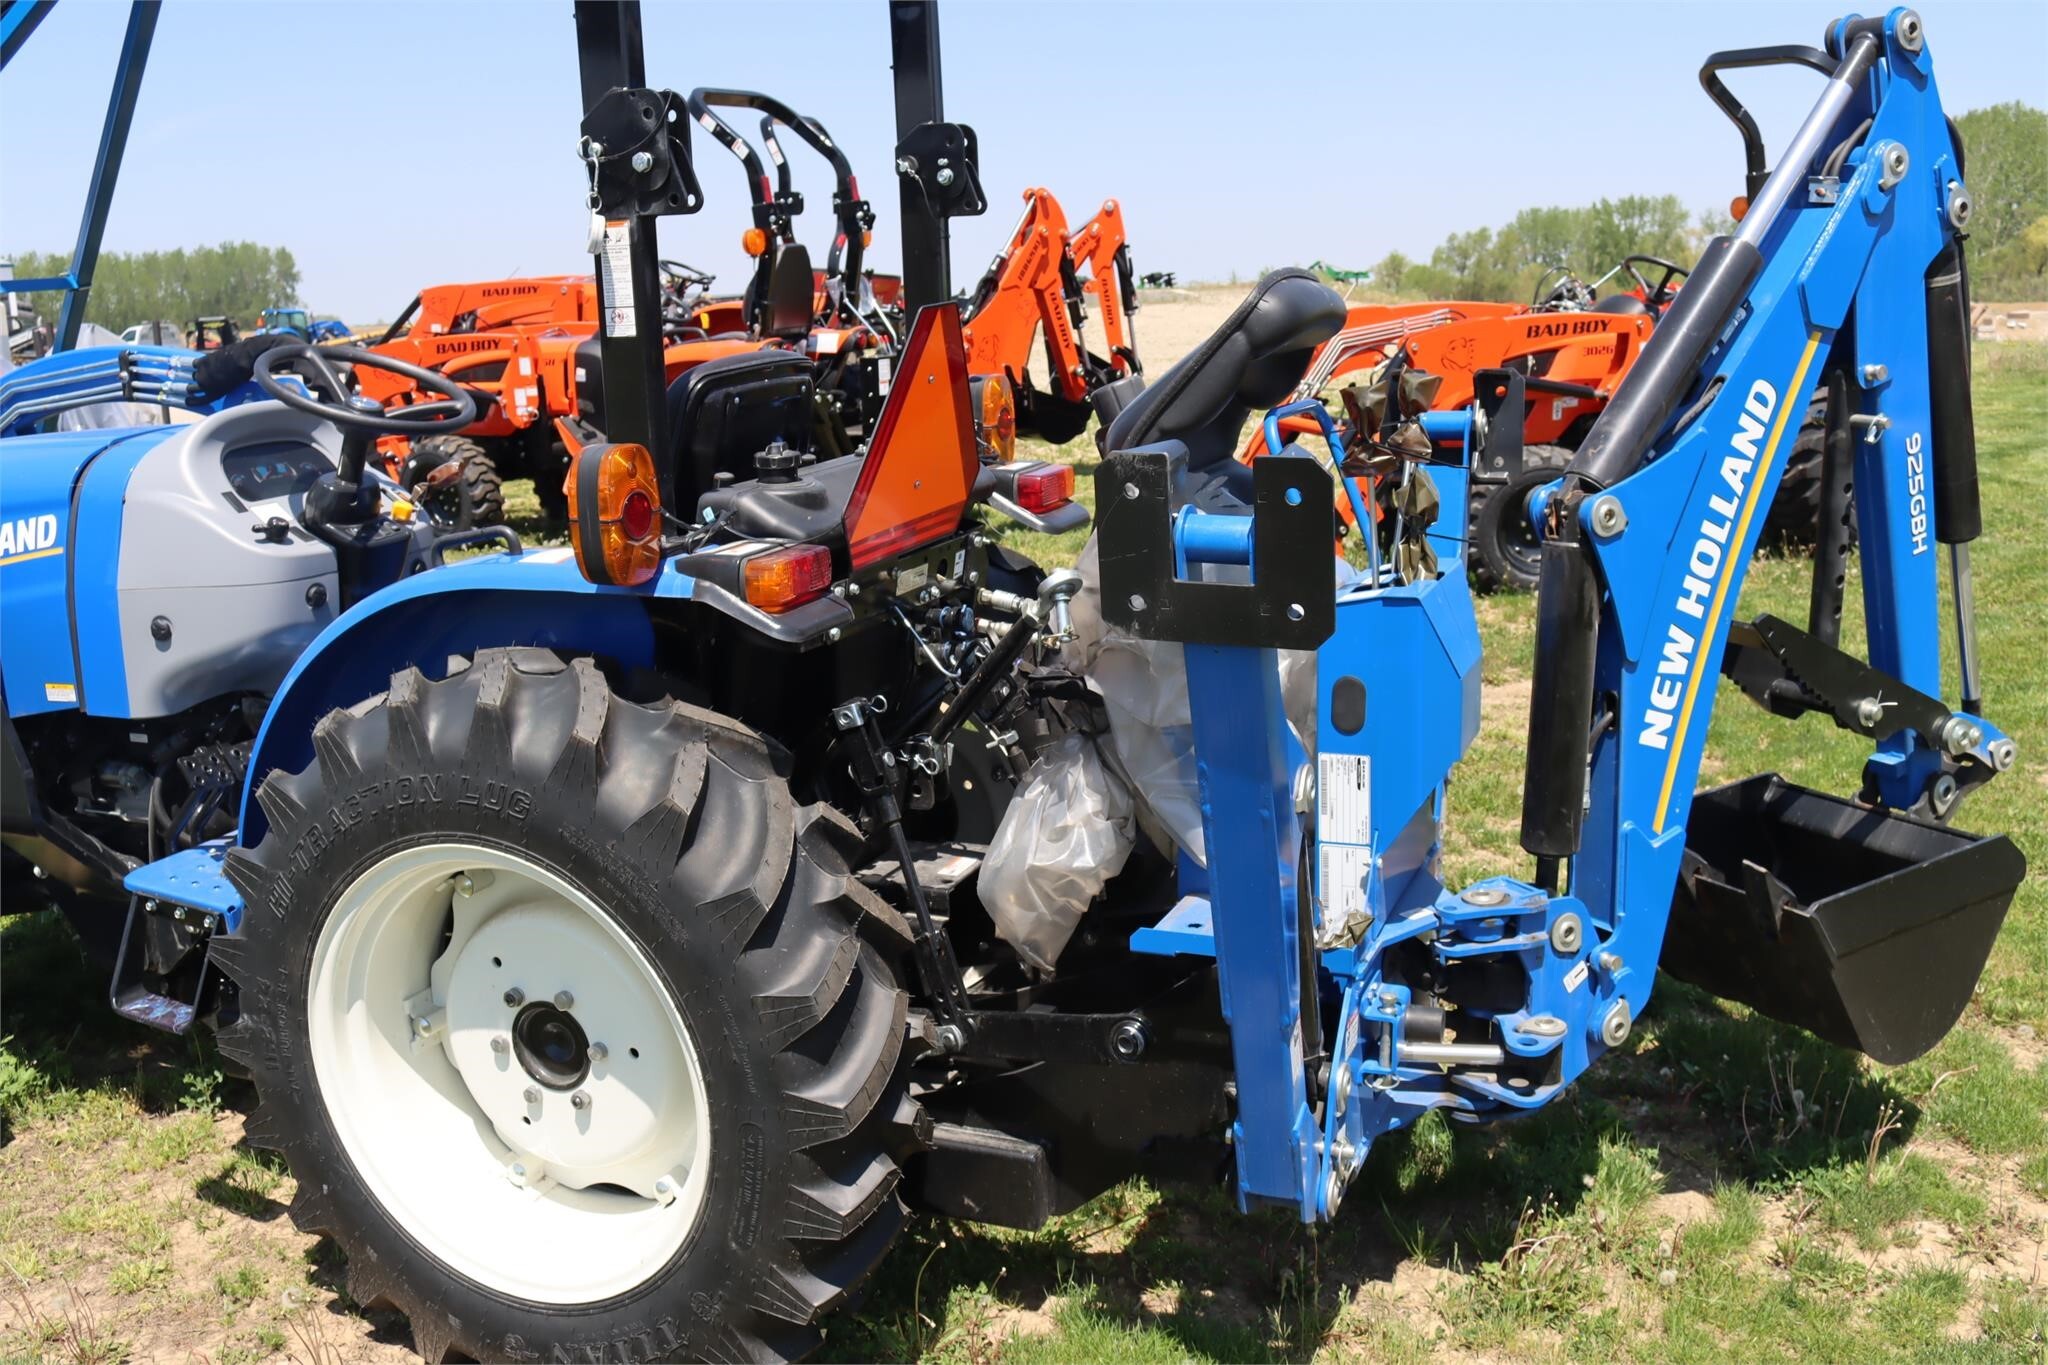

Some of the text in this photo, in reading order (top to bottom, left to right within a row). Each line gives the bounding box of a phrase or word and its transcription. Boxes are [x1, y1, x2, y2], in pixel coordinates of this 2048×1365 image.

[482, 285, 540, 297] BAD BOY
[1050, 291, 1071, 349] BAD BOY
[436, 339, 502, 354] BAD BOY
[1527, 319, 1612, 338] BAD BOY
[1905, 432, 1928, 555] 925GBH
[1638, 378, 1777, 750] NEW HOLLAND
[267, 773, 445, 919] HI-TRACTION
[456, 775, 532, 820] LUG
